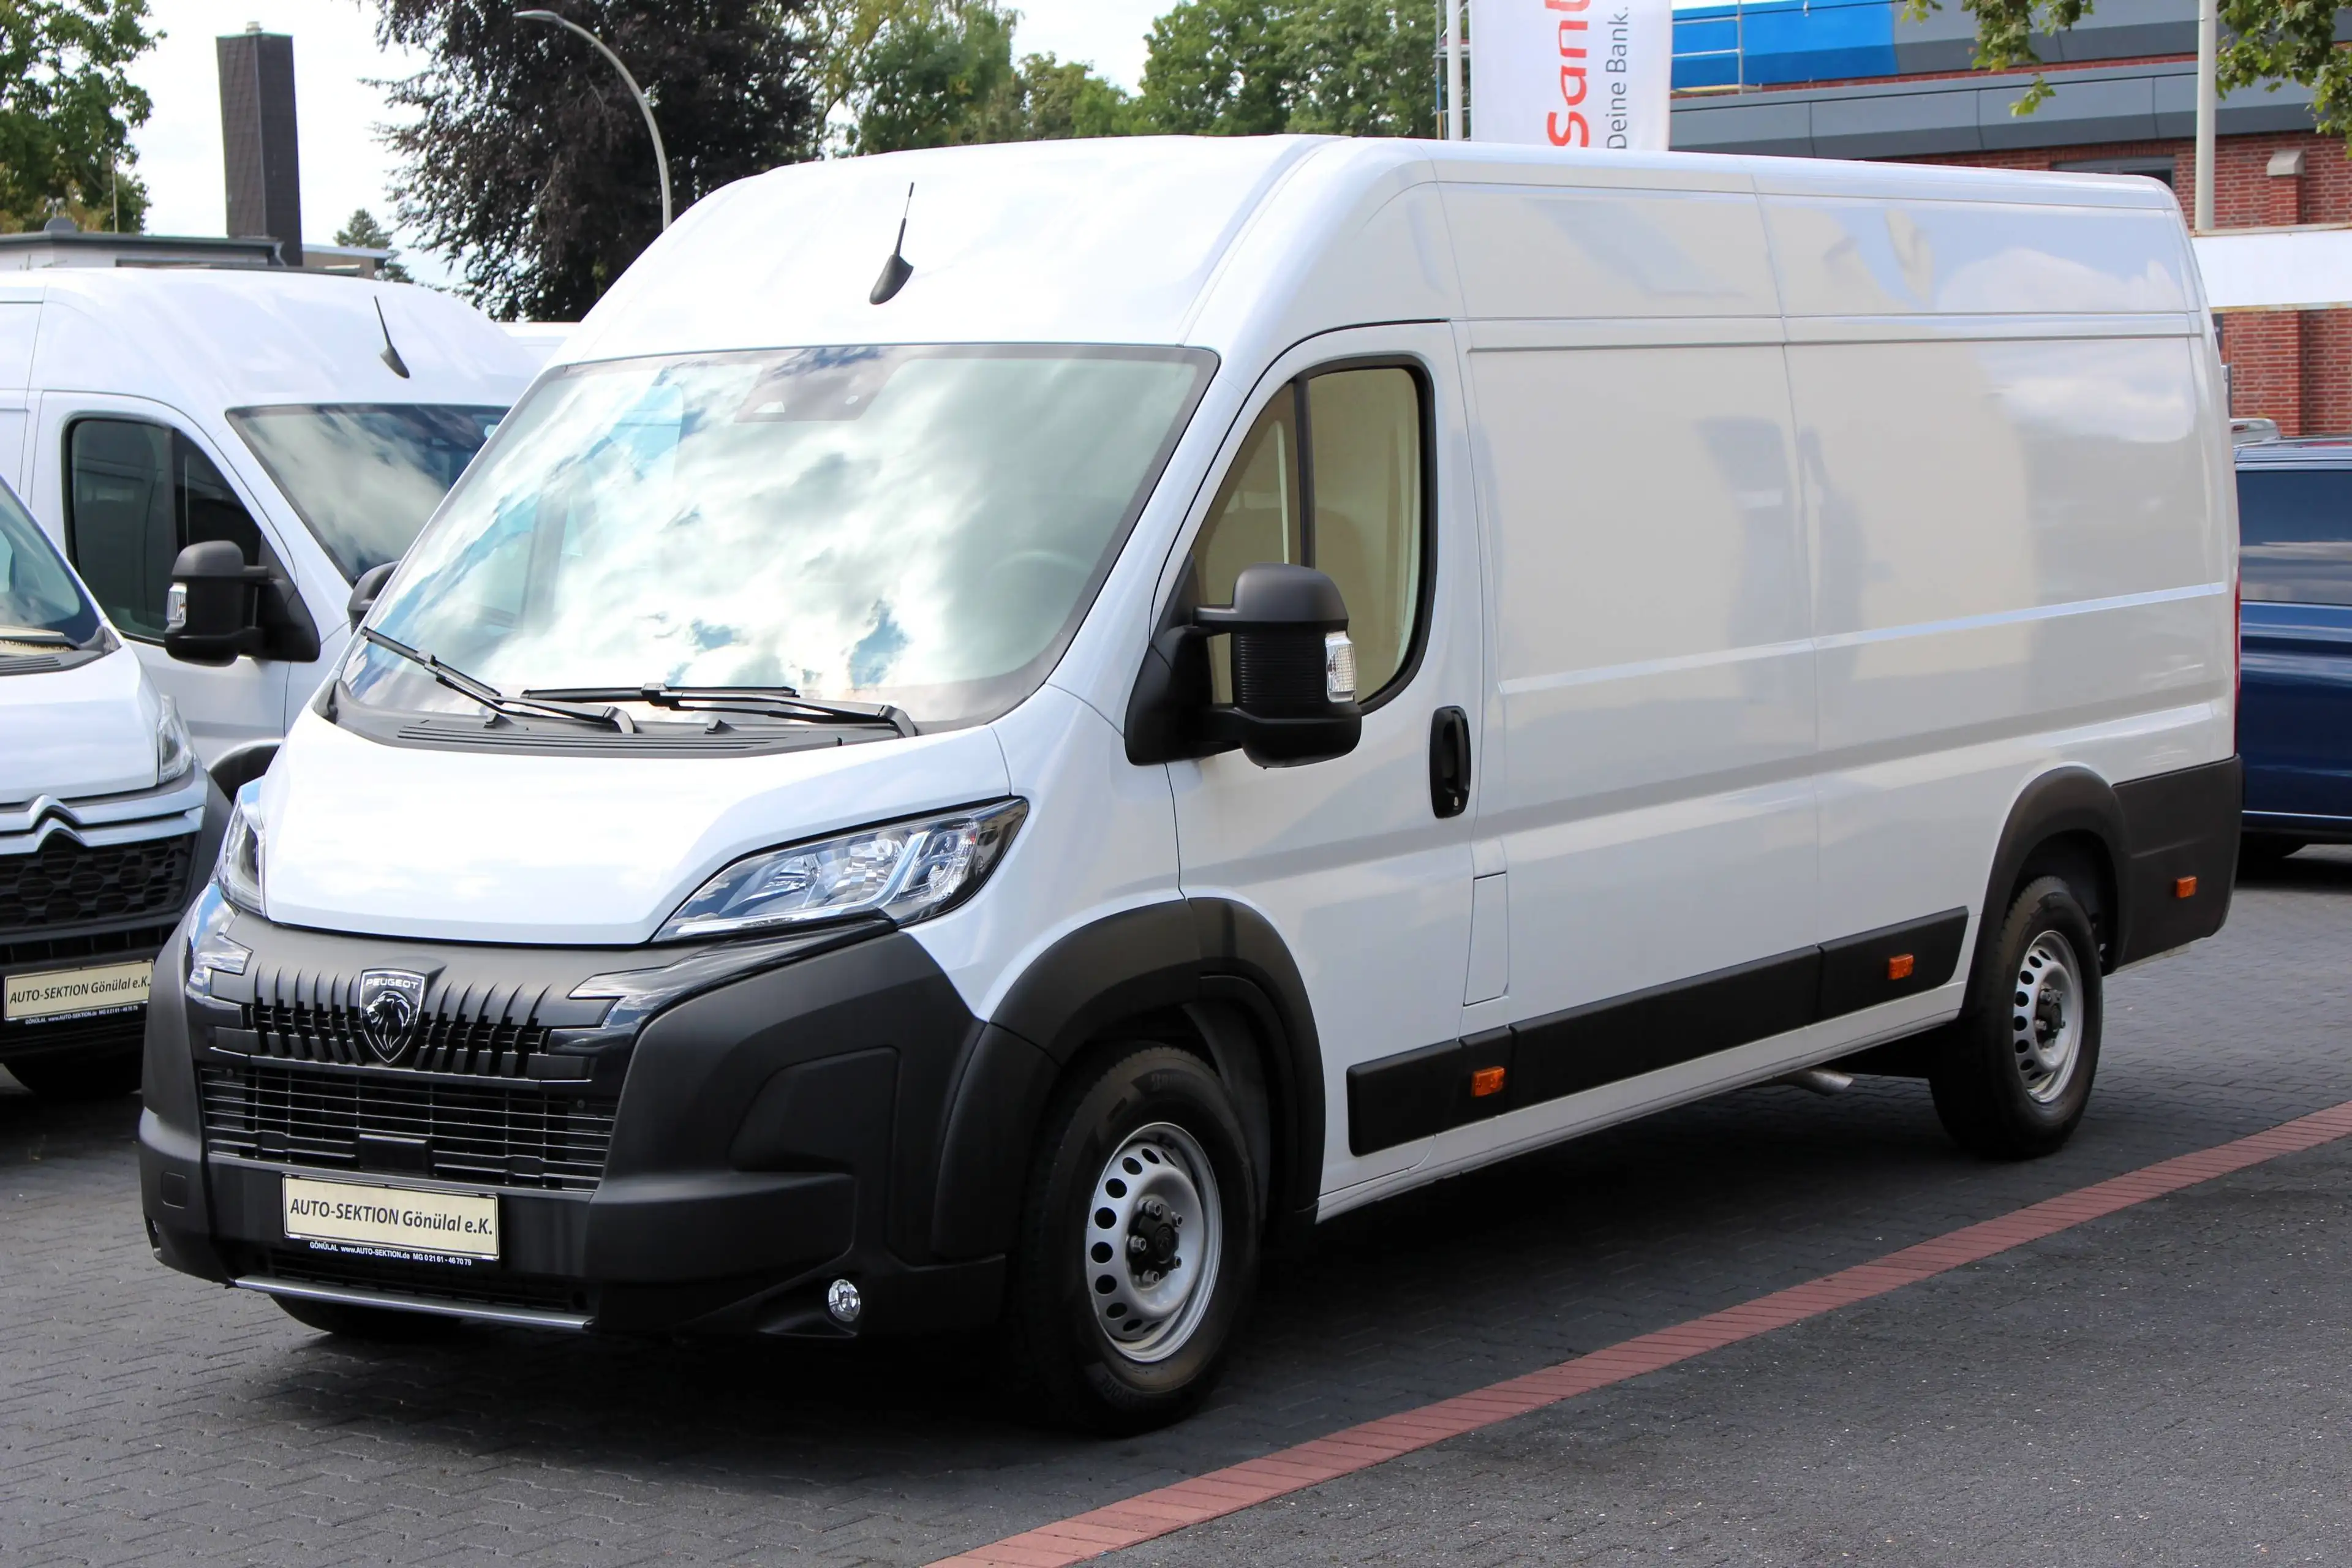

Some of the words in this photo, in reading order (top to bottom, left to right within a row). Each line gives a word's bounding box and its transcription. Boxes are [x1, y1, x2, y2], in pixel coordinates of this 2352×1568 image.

[1605, 6, 1629, 73] Bank.
[1605, 81, 1627, 149] Deine
[9, 983, 89, 1004] AUTO-SEKTION
[91, 978, 130, 993] Gönülal
[132, 976, 150, 988] e.K.
[366, 978, 419, 989] PEUGEOT
[290, 1198, 400, 1226] AUTO-SEKTION
[402, 1210, 461, 1232] Gönülal
[464, 1218, 492, 1235] e.K.
[309, 1241, 339, 1251] GÖNÜLAL
[341, 1246, 410, 1259] www.AUTO-SEKTION.de
